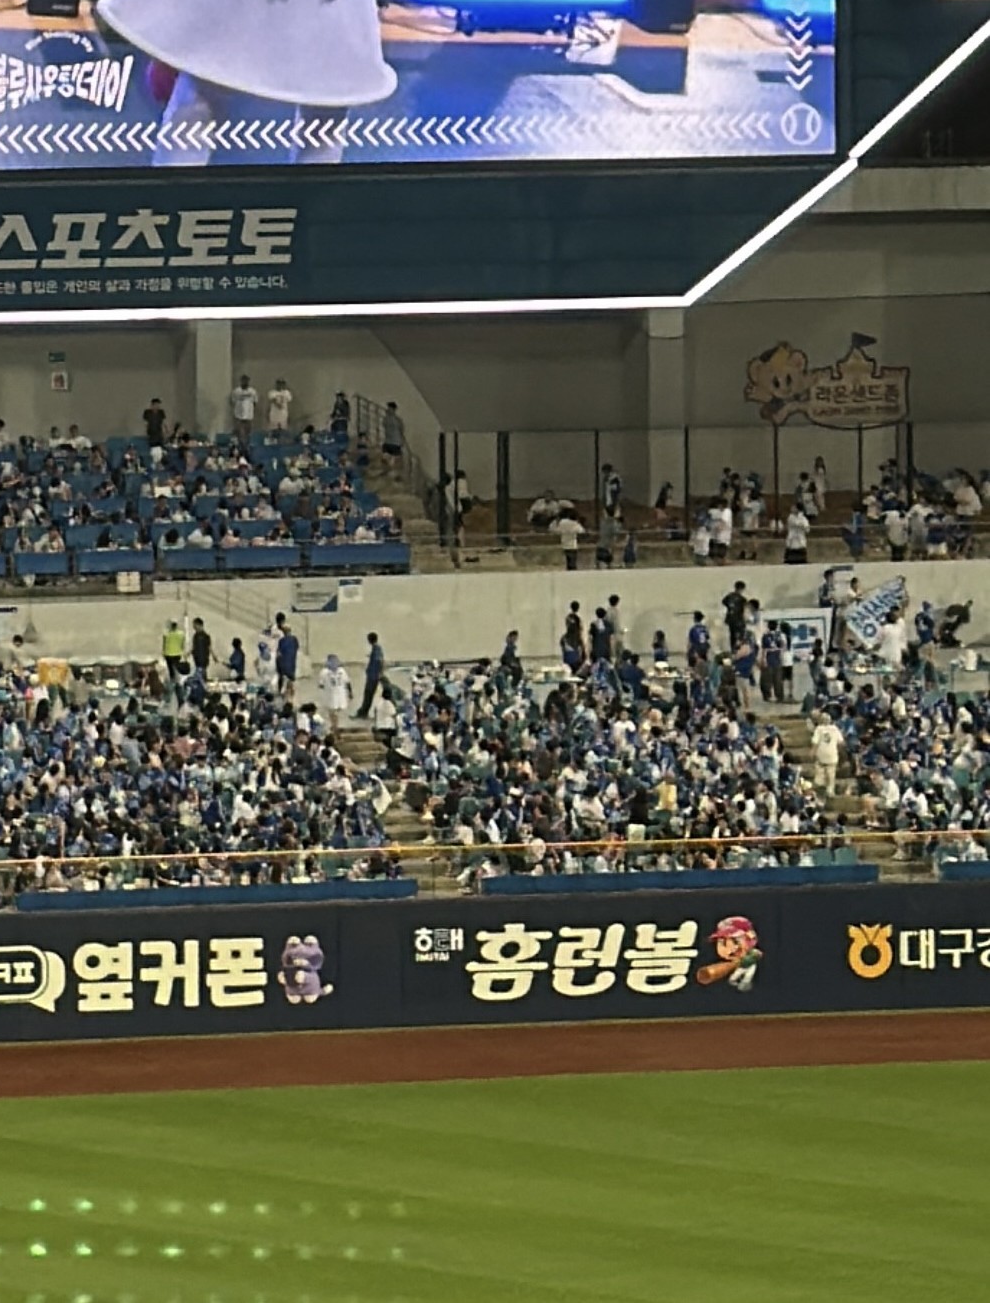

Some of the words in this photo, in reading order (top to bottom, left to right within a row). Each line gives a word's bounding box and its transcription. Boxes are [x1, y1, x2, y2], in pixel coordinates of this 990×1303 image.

[218, 276, 233, 290] 수
[72, 937, 268, 1012] 옆커폰
[465, 920, 699, 1001] 홈런볼
